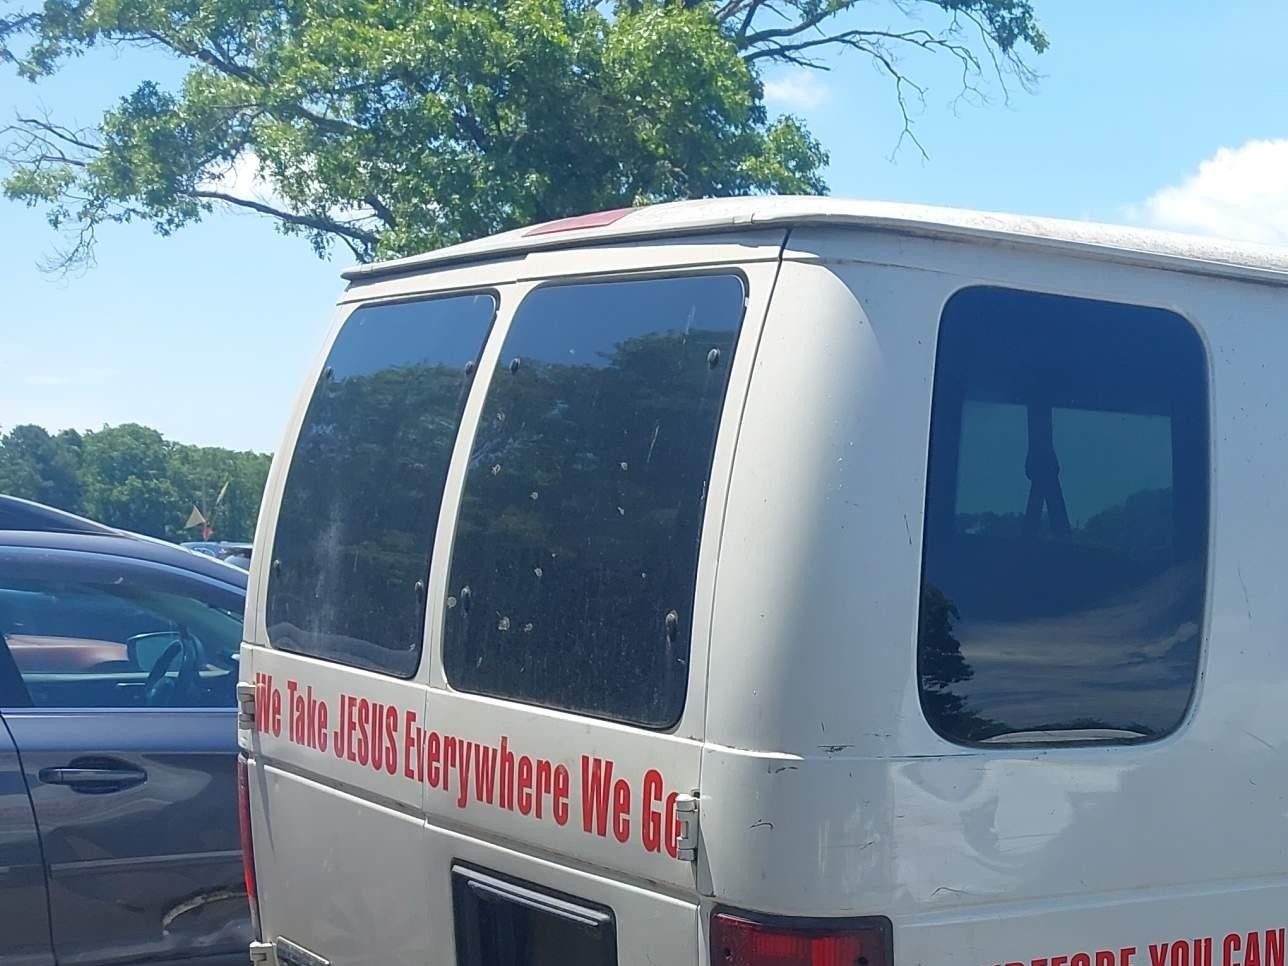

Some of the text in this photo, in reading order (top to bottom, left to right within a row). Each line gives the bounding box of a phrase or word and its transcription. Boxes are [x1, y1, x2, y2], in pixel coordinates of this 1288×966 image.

[255, 672, 282, 737] We
[287, 680, 328, 752] Take
[333, 695, 399, 776] JESUS
[404, 709, 570, 826] Everywhere
[581, 754, 631, 843] We
